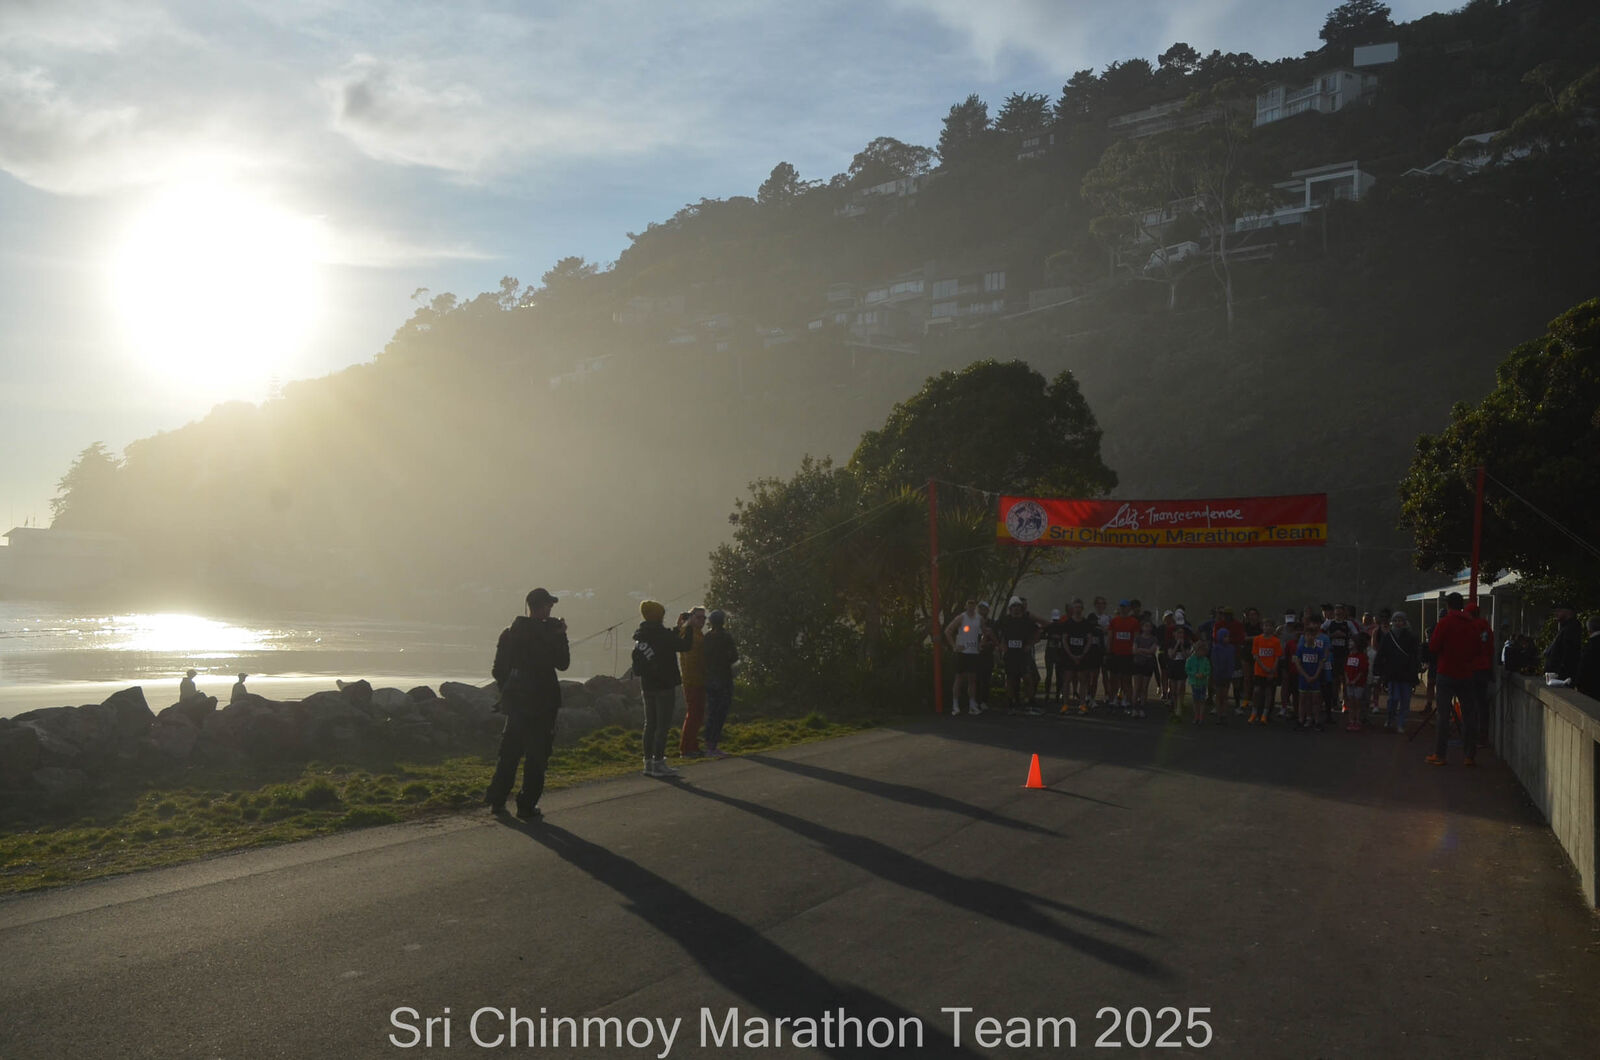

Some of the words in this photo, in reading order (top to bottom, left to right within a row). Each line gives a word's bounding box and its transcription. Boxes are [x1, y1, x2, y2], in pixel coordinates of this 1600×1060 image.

[1100, 502, 1243, 531] Self-Transcendence
[1050, 526, 1074, 540] Sri
[1079, 528, 1160, 547] Chinmoy
[1166, 528, 1259, 543] Marathon
[1264, 525, 1321, 540] Team
